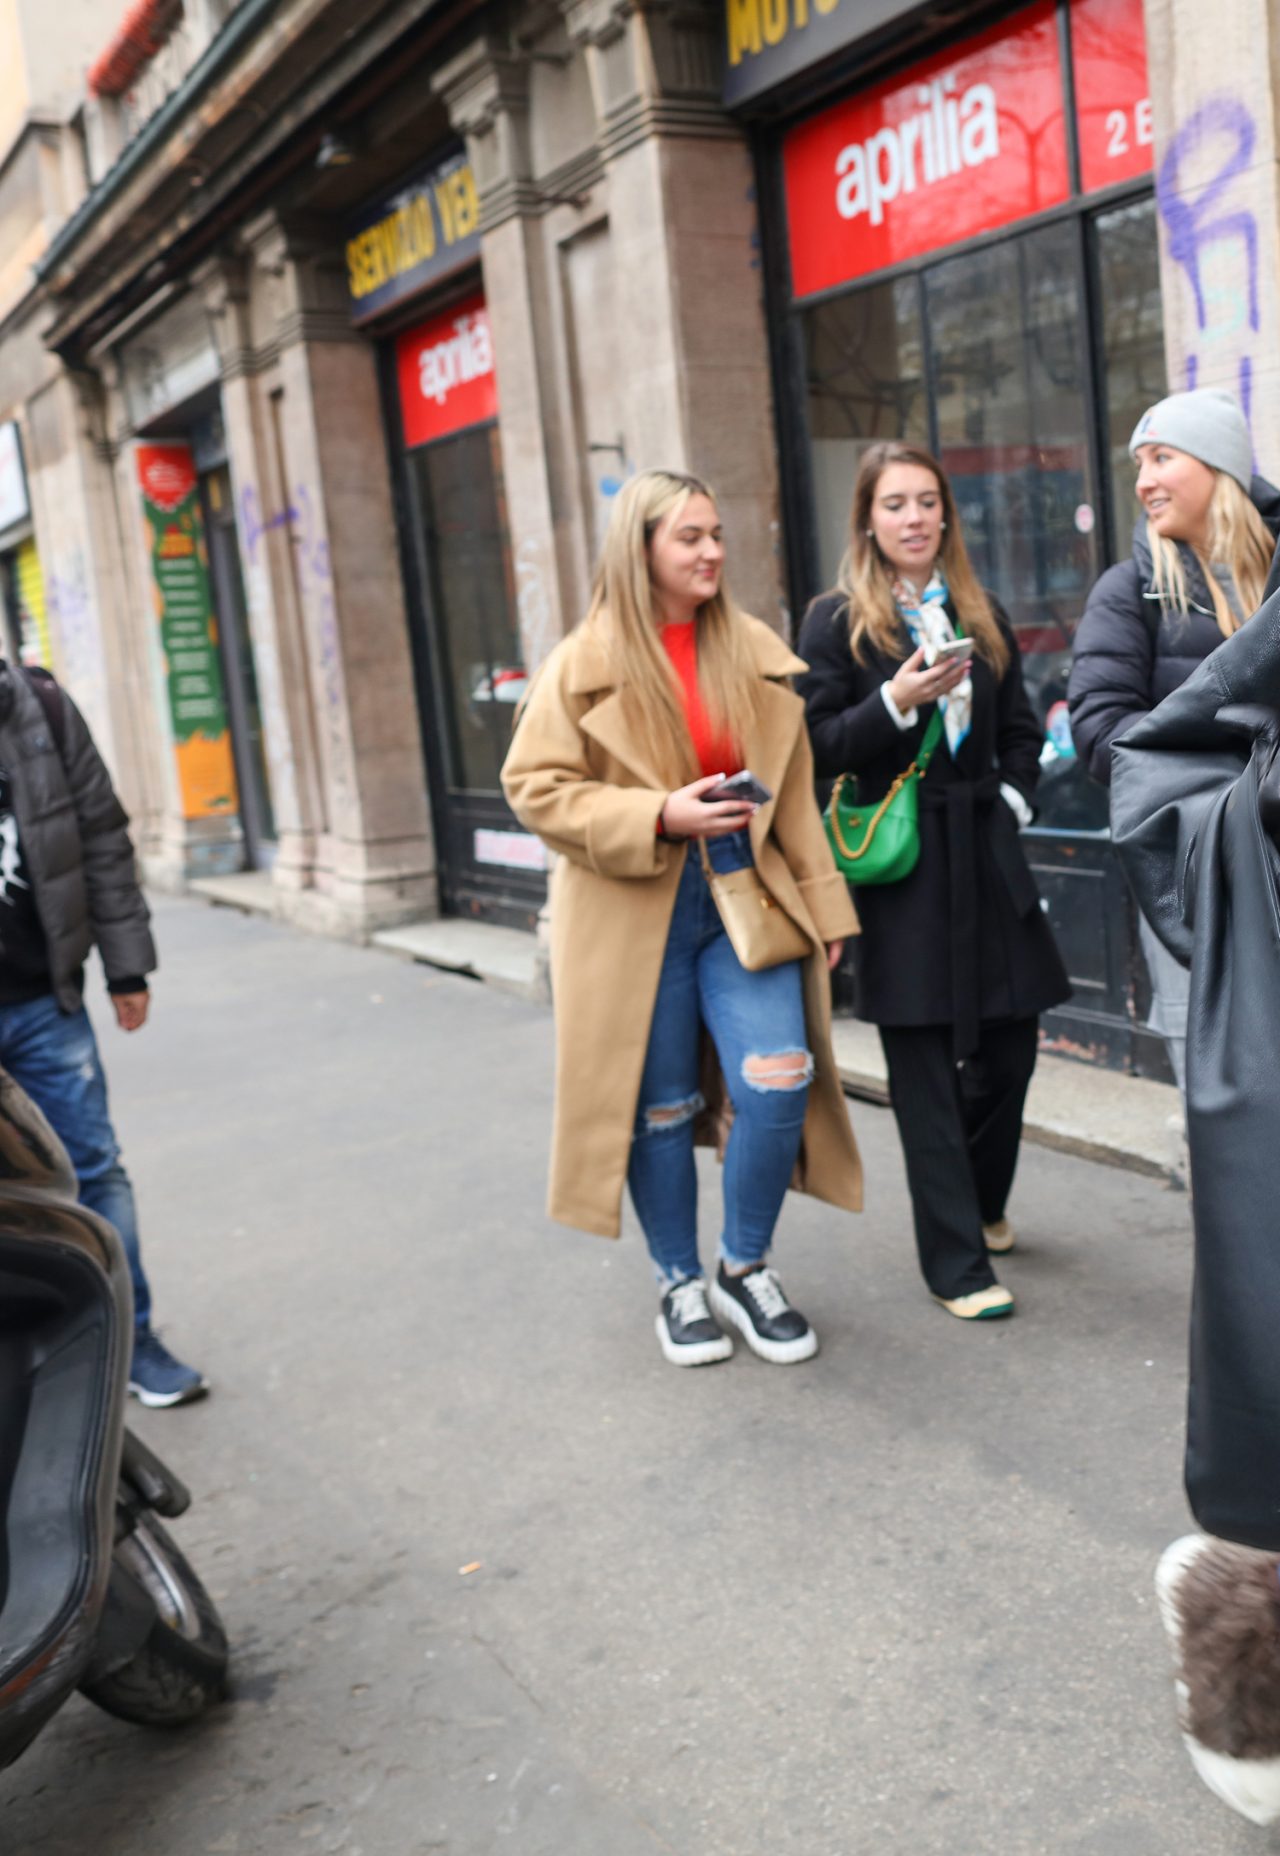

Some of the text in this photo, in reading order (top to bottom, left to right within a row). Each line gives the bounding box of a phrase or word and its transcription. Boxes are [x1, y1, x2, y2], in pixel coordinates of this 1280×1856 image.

[835, 74, 998, 226] aprilia
[1105, 110, 1129, 158] 2
[418, 312, 494, 406] aprilia
